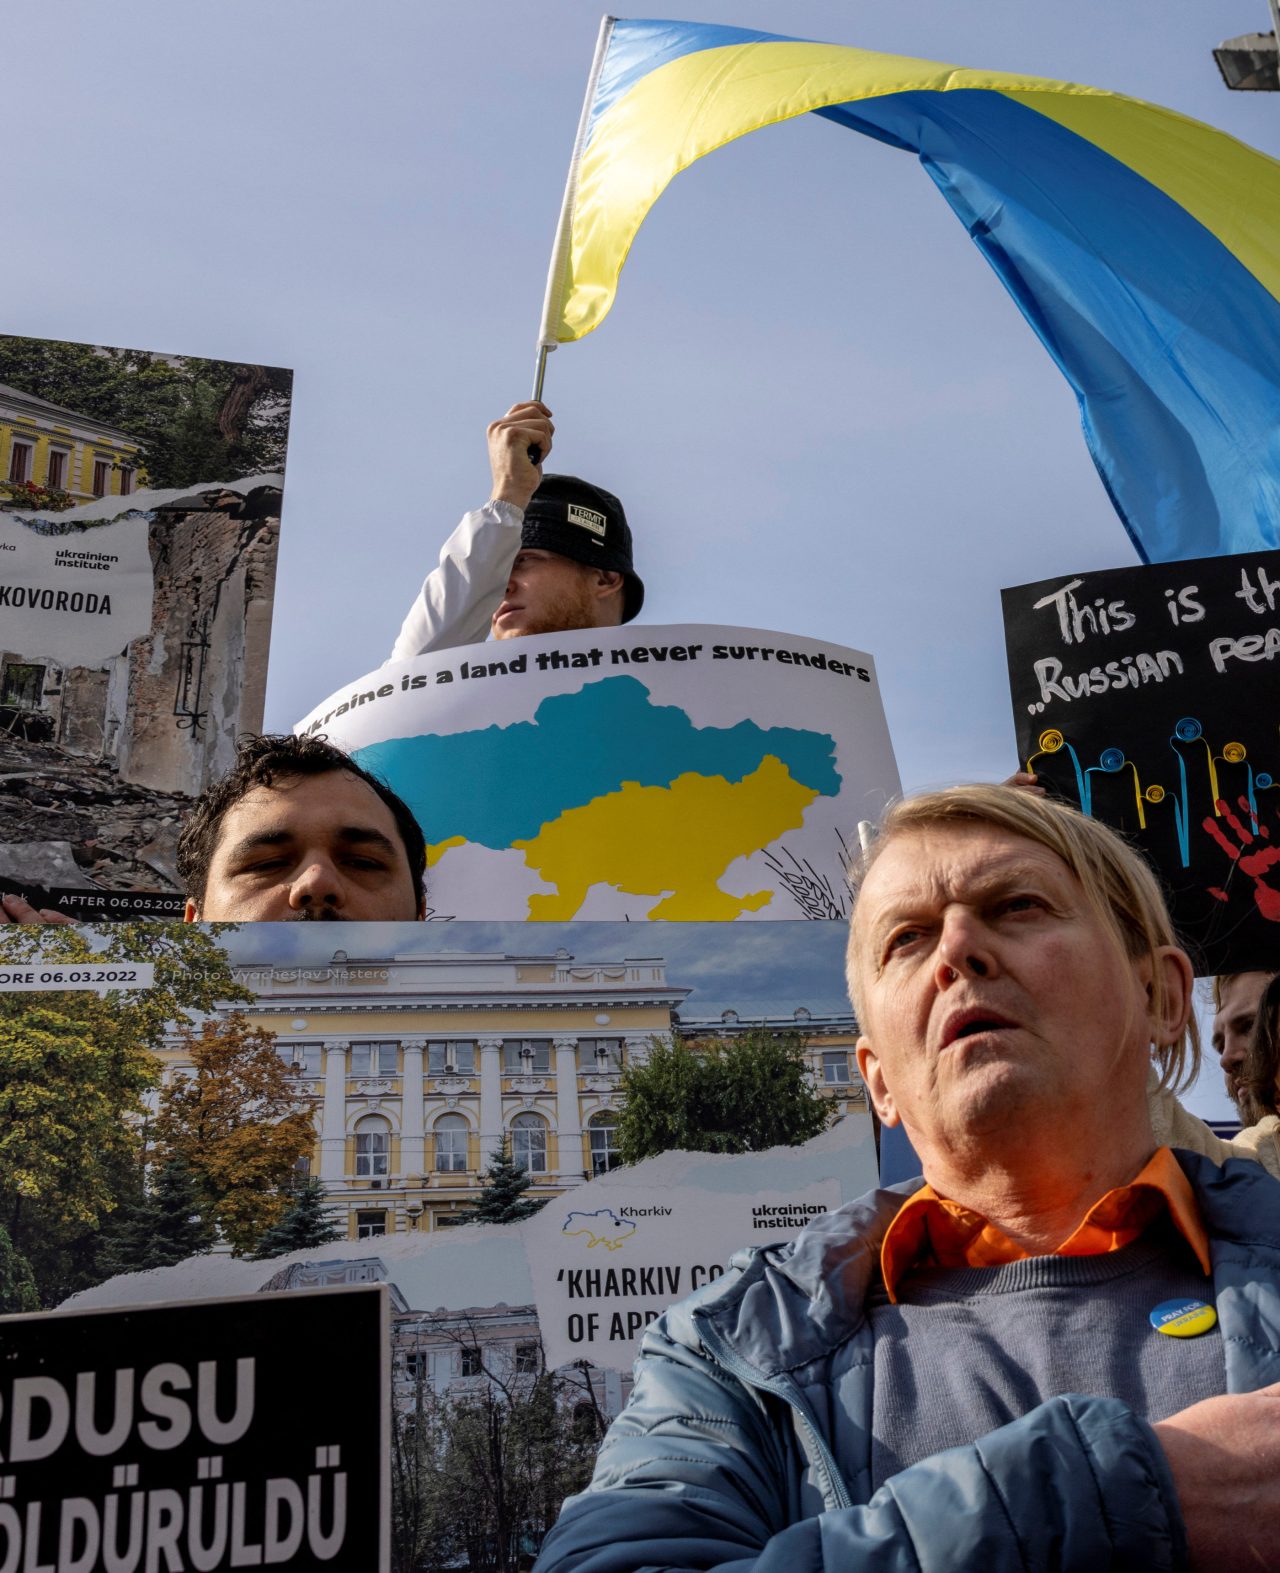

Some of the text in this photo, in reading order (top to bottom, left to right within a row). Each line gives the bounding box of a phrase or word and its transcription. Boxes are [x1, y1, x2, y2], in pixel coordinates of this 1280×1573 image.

[573, 508, 602, 524] TERMIT
[56, 549, 119, 563] ukrainian
[54, 558, 110, 570] institute
[1033, 578, 1136, 645] This
[1164, 585, 1206, 626] is
[401, 674, 427, 691] is
[436, 670, 454, 684] a
[460, 654, 527, 680] land
[535, 648, 601, 670] that
[611, 644, 702, 664] never
[713, 644, 870, 682] surrenders
[59, 895, 106, 907] AFTER
[40, 971, 137, 983] 06.03.2022
[172, 967, 398, 983] Photo: Vyacheslav Nesterov
[620, 1206, 672, 1217] Kharkiv
[752, 1203, 827, 1216] ukrainian
[753, 1216, 811, 1228] institut
[567, 1313, 599, 1342] OF
[0, 1357, 255, 1462] DUSU
